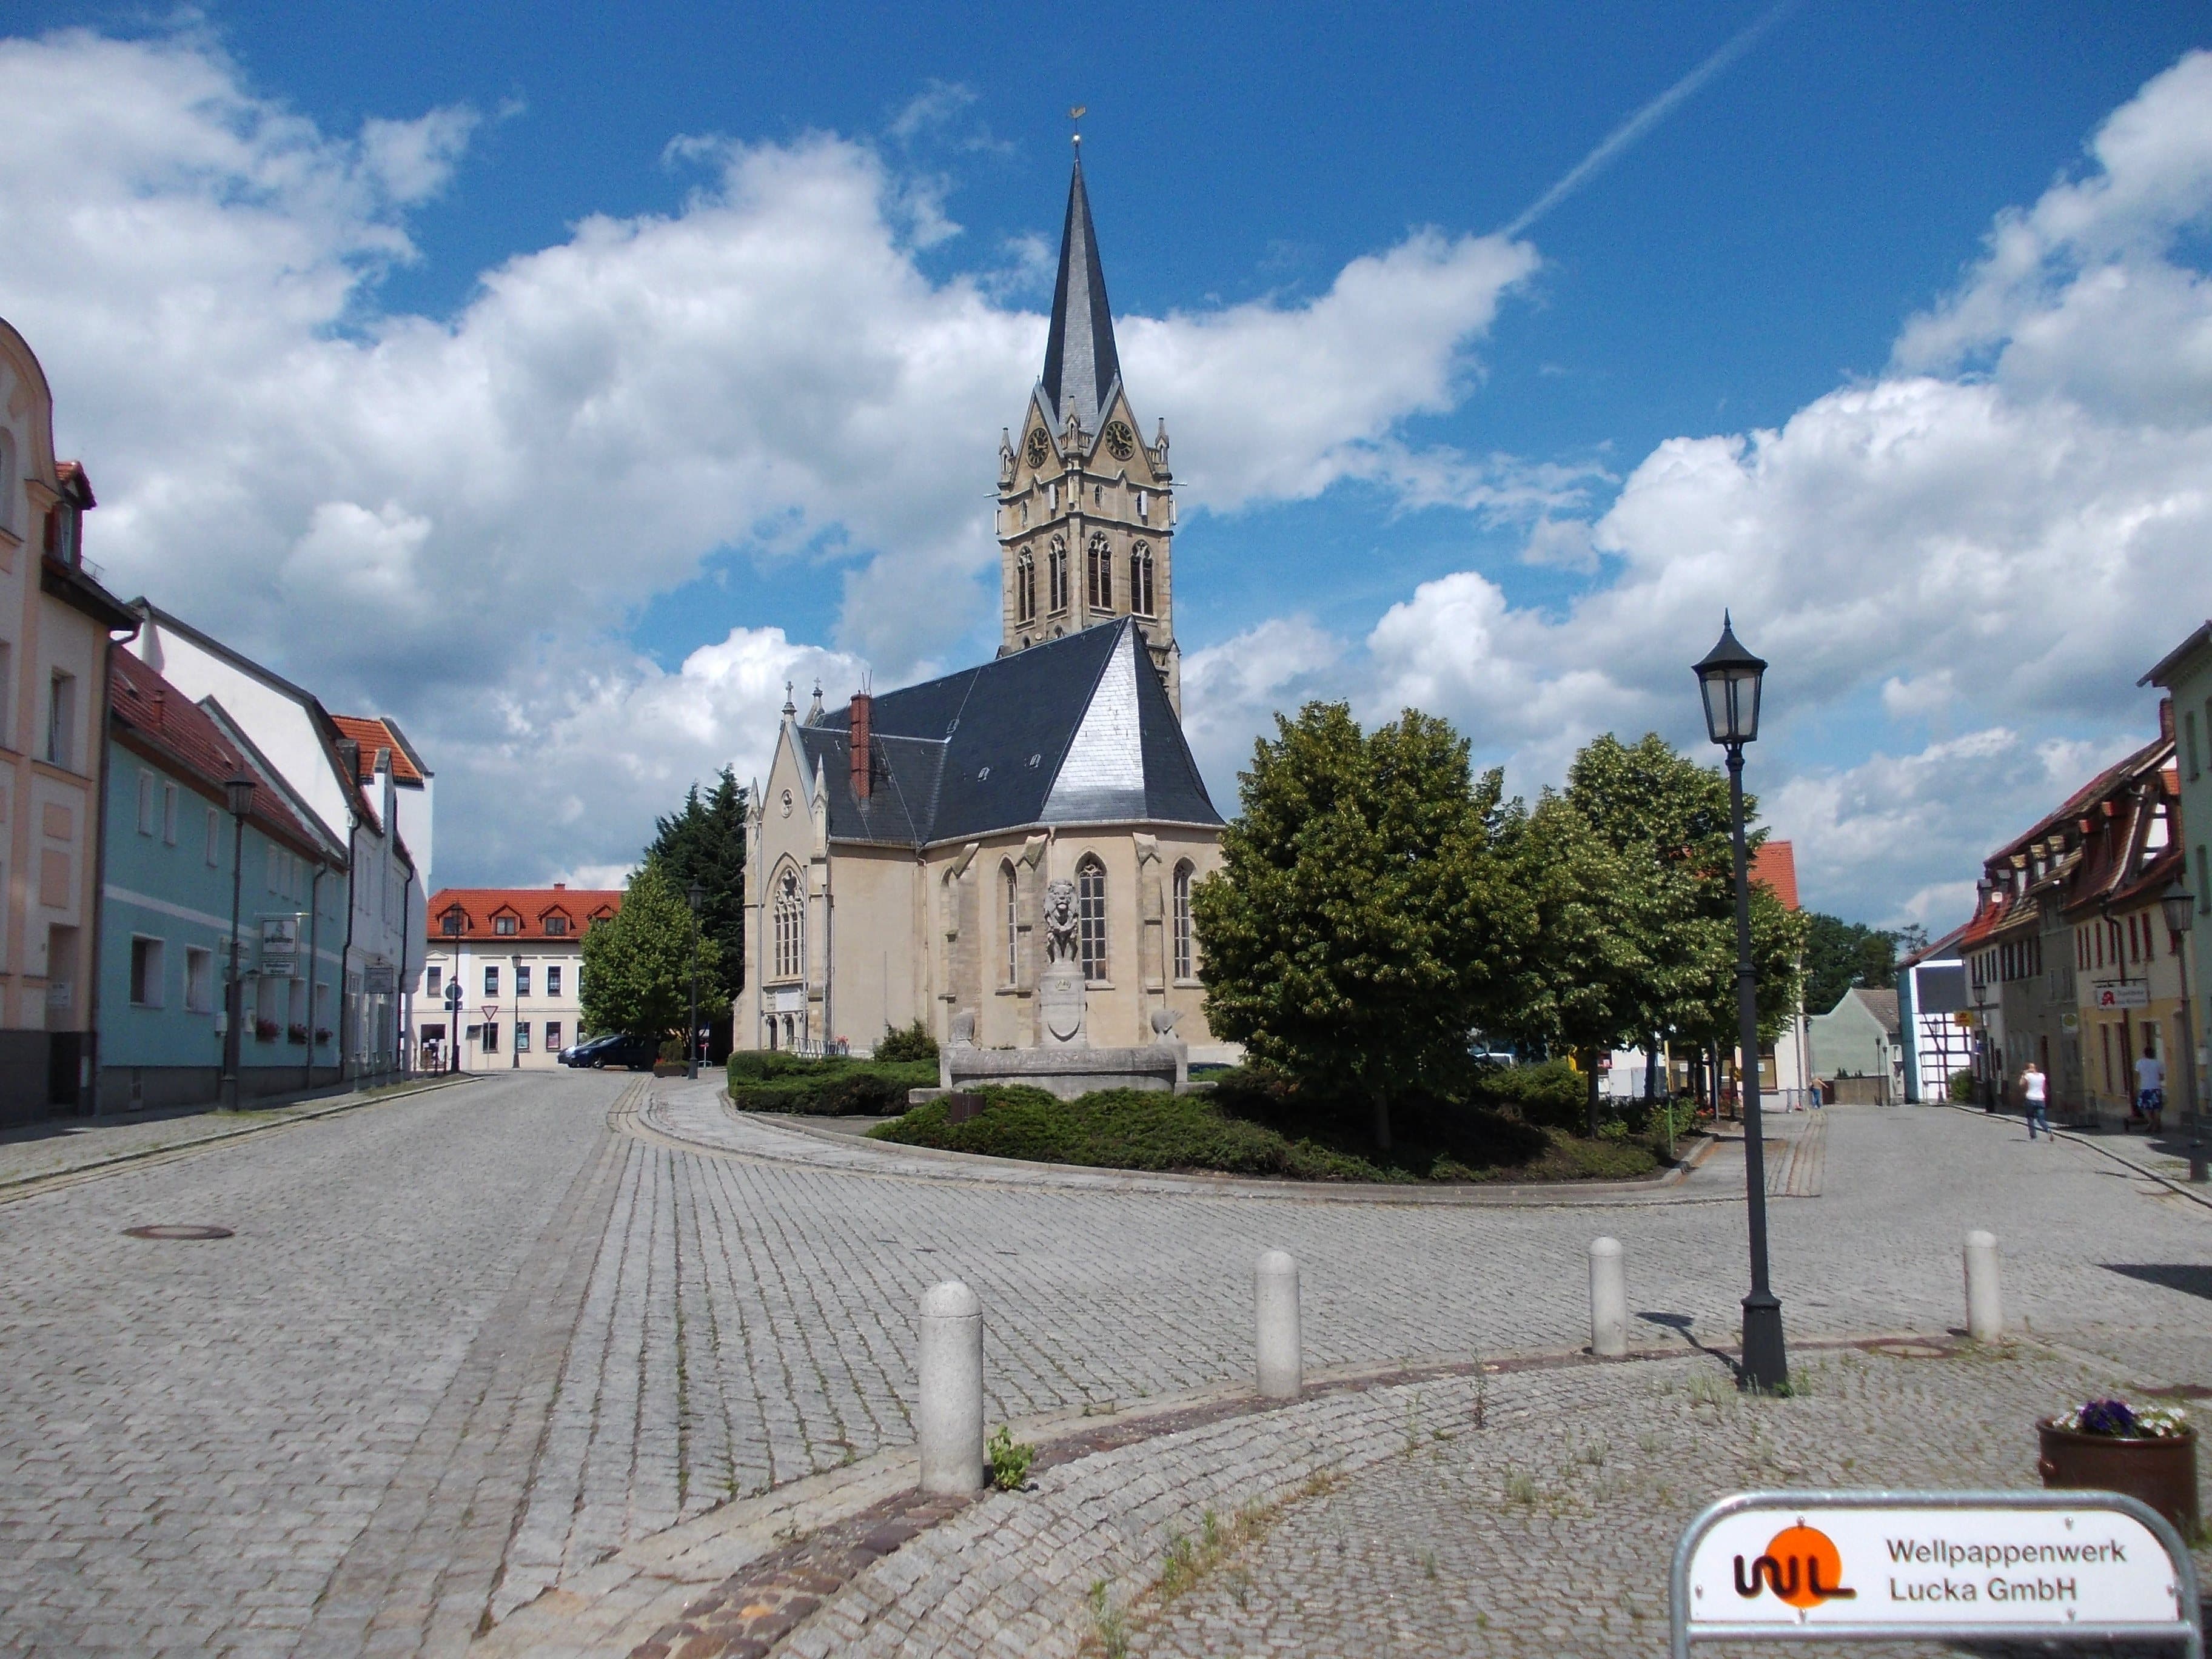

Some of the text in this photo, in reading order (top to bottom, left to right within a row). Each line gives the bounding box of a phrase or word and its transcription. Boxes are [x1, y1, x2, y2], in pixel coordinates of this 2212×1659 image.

[1886, 1539, 2127, 1568] Wellpappenwerk
[1890, 1577, 2077, 1601] Lucka GmbH
